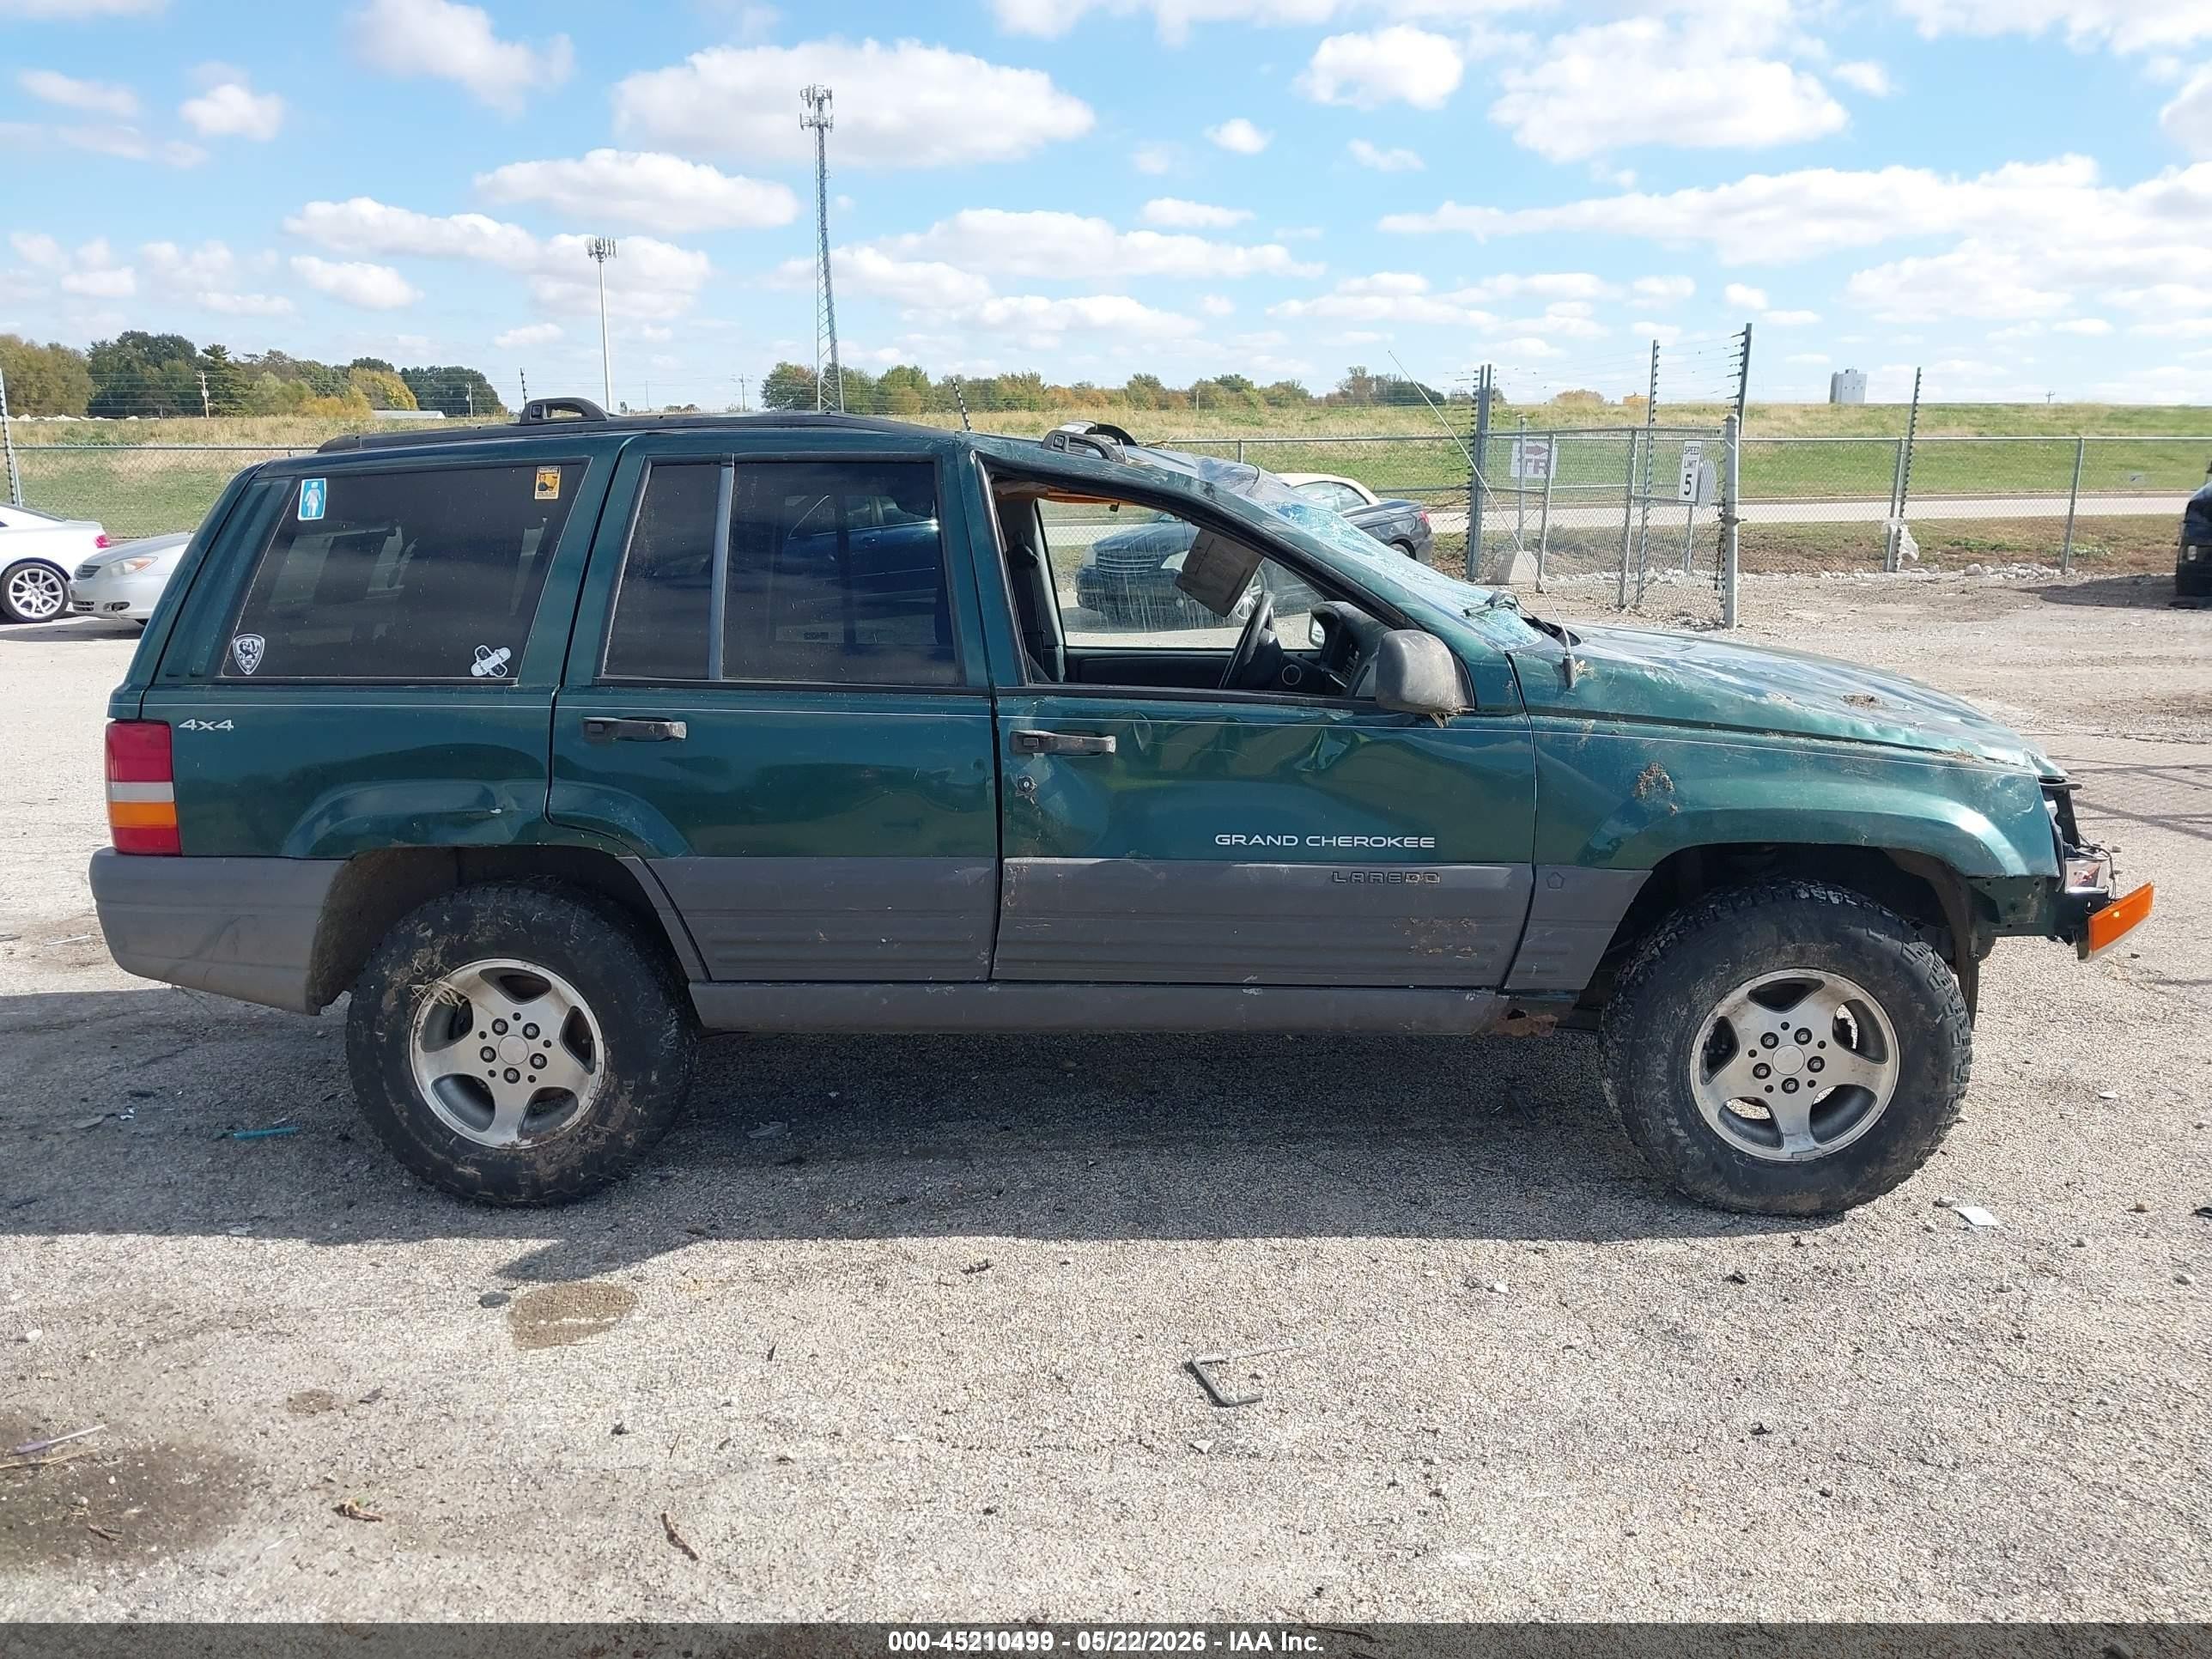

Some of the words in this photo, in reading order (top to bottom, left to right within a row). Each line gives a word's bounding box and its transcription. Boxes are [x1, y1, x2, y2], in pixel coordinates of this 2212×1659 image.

[1684, 446, 1700, 455] SPEED
[1683, 459, 1698, 469] LIMIT
[1683, 473, 1692, 495] 5
[178, 719, 234, 732] 4x4
[1214, 834, 1298, 846] GRAND
[1305, 836, 1436, 848] CHEROKEE
[1332, 872, 1441, 884] LAREDO
